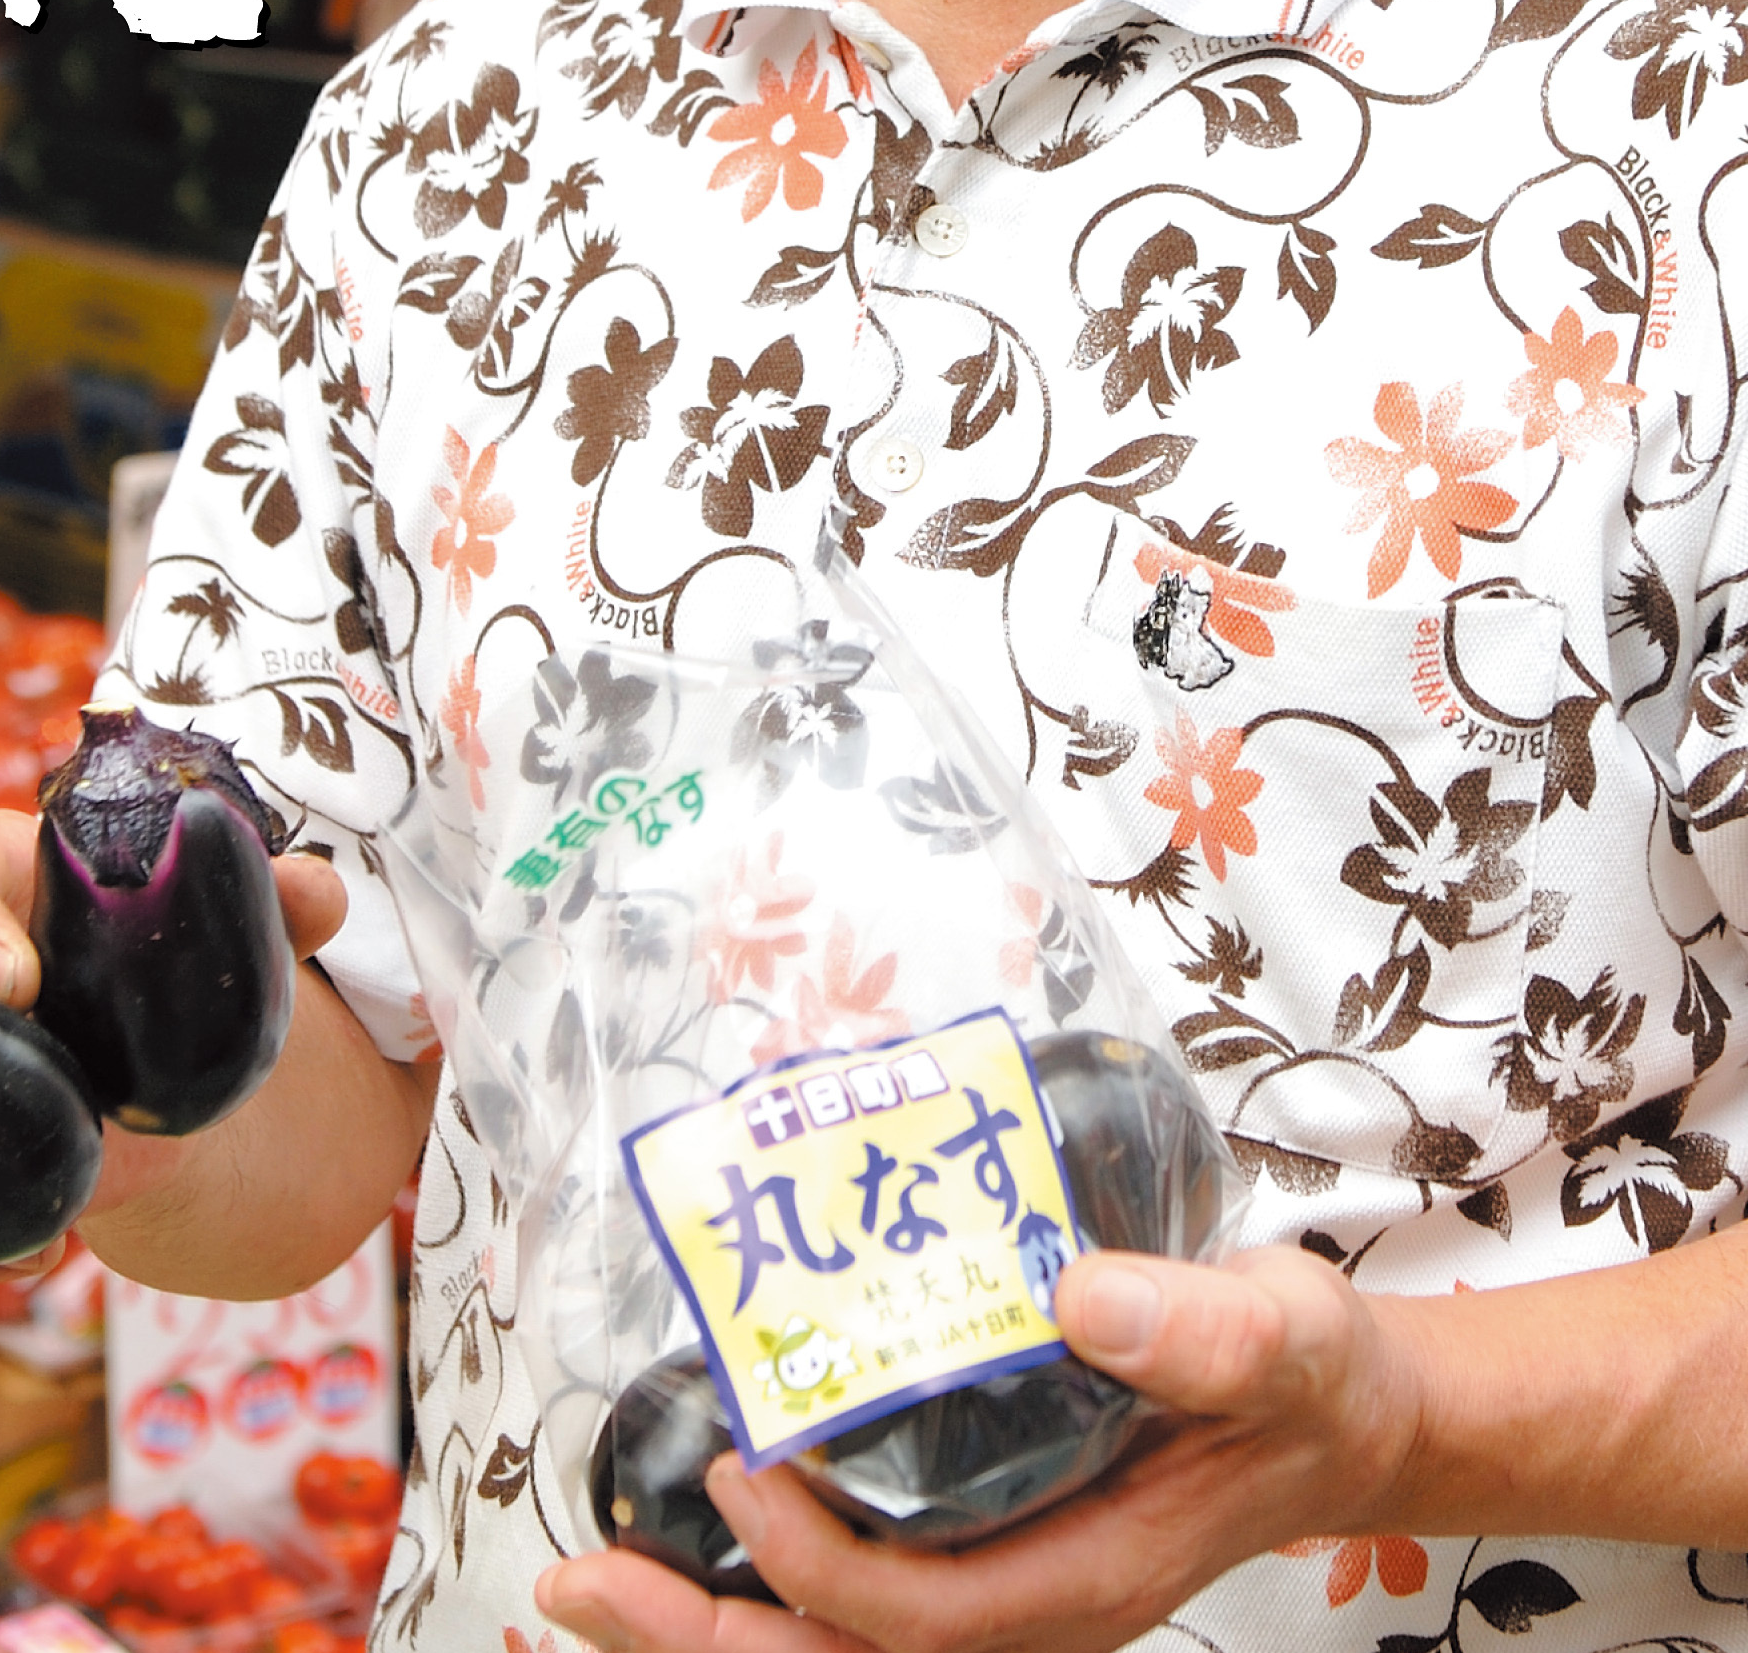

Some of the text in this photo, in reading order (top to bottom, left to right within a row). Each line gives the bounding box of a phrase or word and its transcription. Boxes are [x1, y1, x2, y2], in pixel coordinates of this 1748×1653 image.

[1614, 144, 1679, 349] Black&White
[565, 500, 662, 640] Black&White
[703, 1086, 1022, 1322] 丸なす
